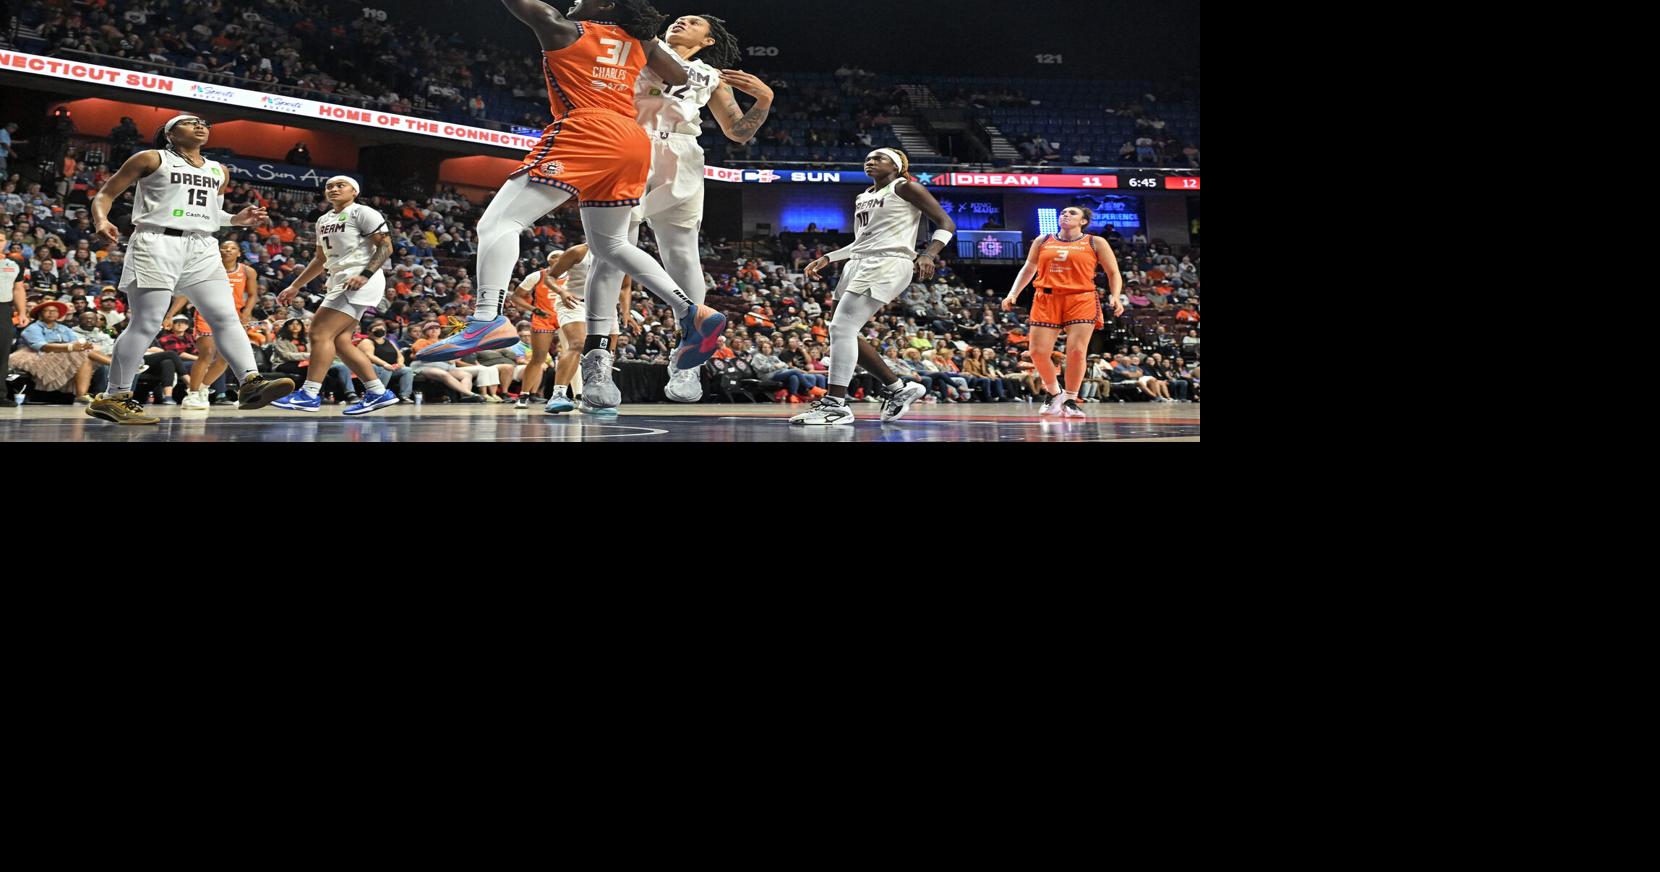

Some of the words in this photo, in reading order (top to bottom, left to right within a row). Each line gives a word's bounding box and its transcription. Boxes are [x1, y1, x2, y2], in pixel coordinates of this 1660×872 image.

[361, 7, 387, 21] 119
[596, 38, 632, 67] 31
[746, 46, 778, 56] 120
[1035, 54, 1063, 64] 121
[592, 66, 627, 80] CHARLES
[126, 74, 173, 91] SUN
[319, 105, 371, 122] HOME
[377, 114, 400, 126] OF
[405, 120, 438, 133] THE
[443, 126, 538, 148] CONNECTIC
[256, 164, 296, 180] Sun
[791, 172, 840, 182] SUN
[170, 172, 220, 190] DREAM
[957, 175, 1039, 186] DREAM
[1082, 177, 1102, 187] 11
[1128, 178, 1157, 188] 6:45
[1182, 179, 1197, 188] 12
[187, 188, 208, 207] 15
[1054, 250, 1069, 262] 3
